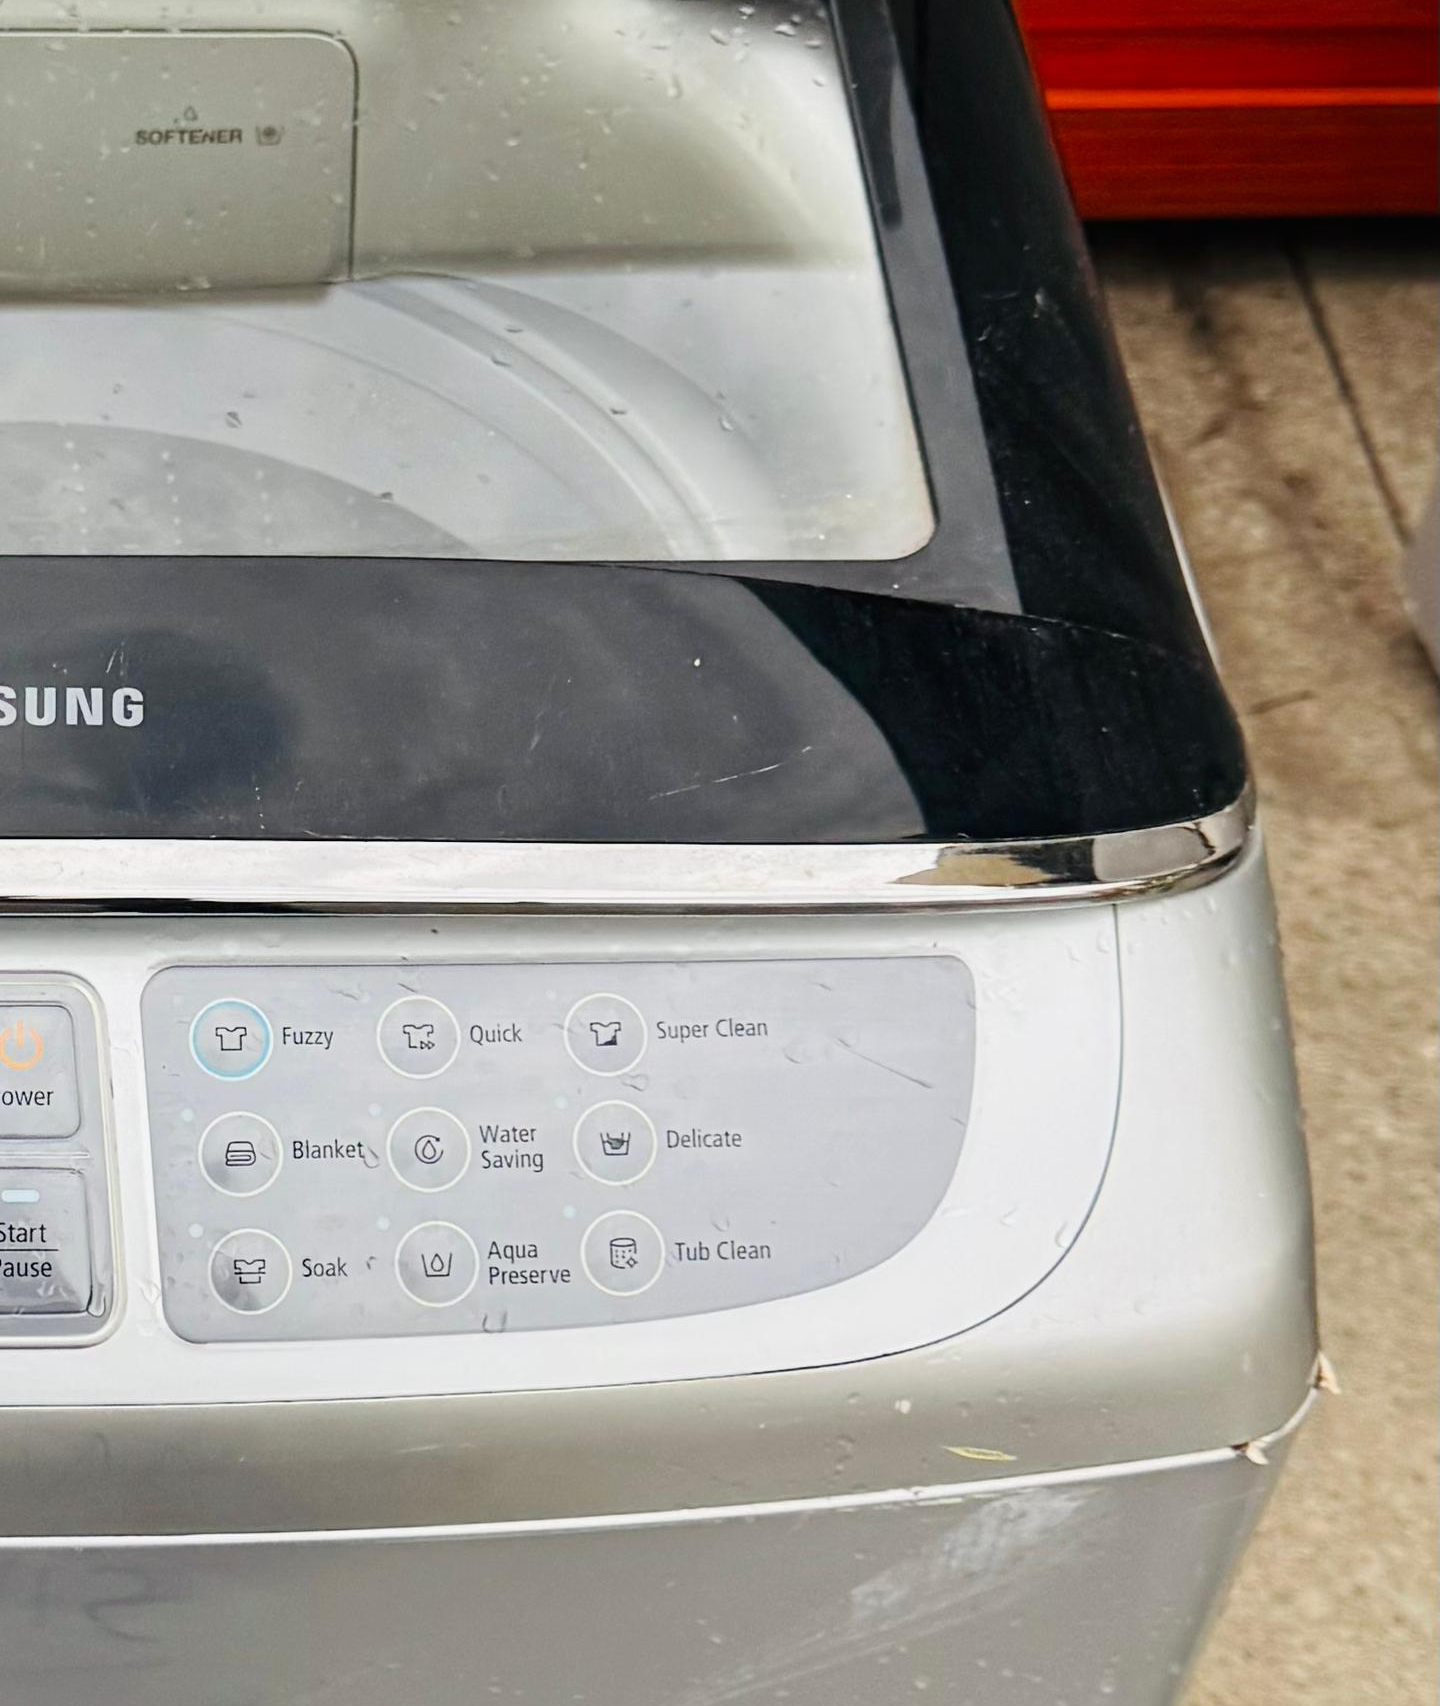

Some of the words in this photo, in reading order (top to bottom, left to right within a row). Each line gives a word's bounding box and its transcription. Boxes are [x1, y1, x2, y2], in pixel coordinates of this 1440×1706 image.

[135, 128, 243, 146] SOFTENER
[282, 1026, 334, 1050] Fuzzy
[470, 1023, 522, 1046] Quick
[656, 1021, 709, 1039] Super
[716, 1018, 768, 1038] Clean
[479, 1124, 537, 1144] Water
[666, 1128, 742, 1149] Delicate
[292, 1139, 365, 1160] Blanket
[481, 1149, 544, 1173] Saving
[487, 1241, 538, 1264] Aqua
[674, 1241, 710, 1261] Tub
[716, 1240, 771, 1261] Clean
[302, 1257, 348, 1278] Soak
[489, 1266, 571, 1285] Preserve
